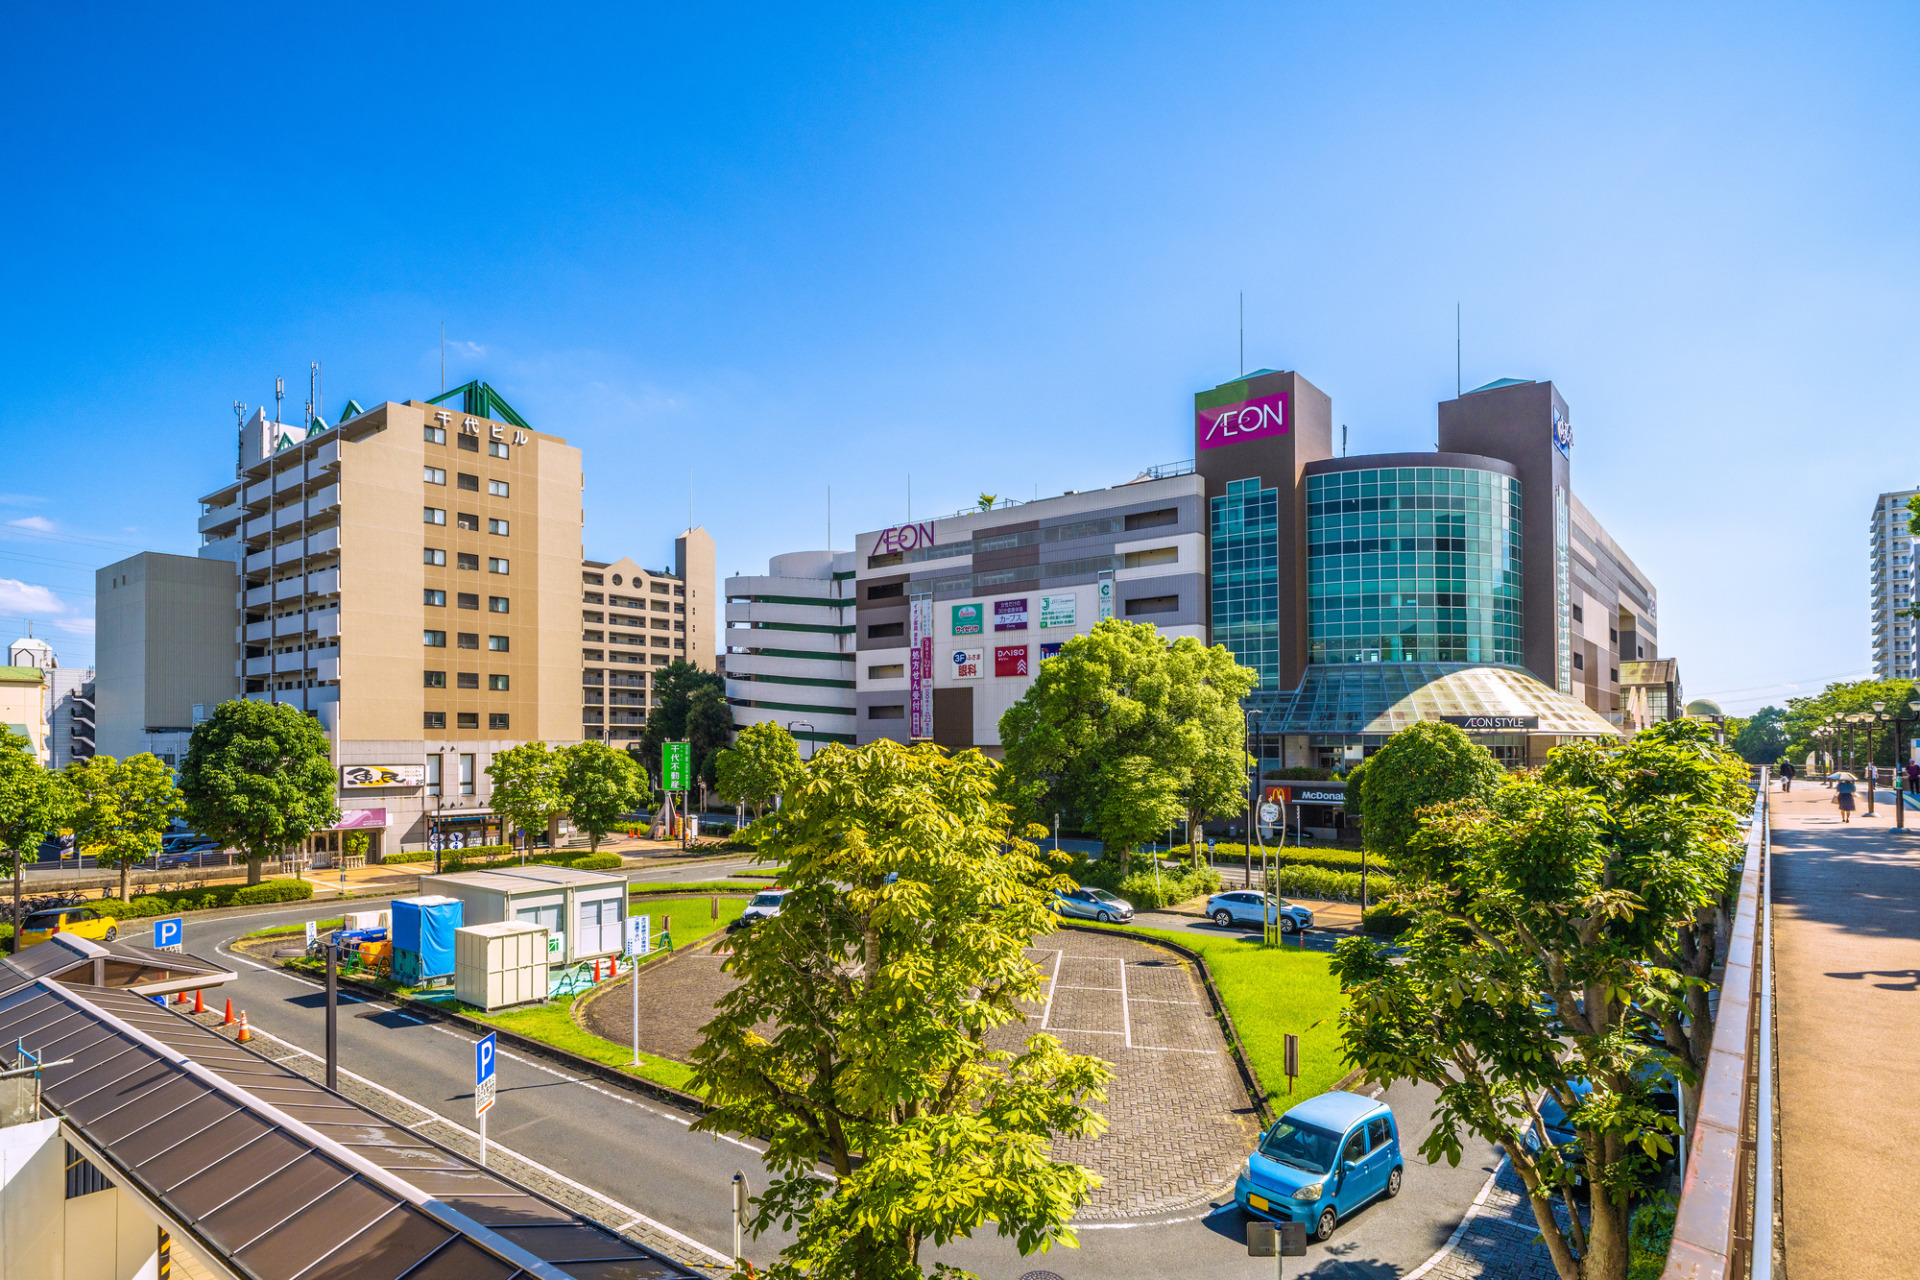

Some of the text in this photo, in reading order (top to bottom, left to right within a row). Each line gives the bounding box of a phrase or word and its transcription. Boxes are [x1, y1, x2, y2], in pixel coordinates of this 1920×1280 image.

[437, 411, 528, 445] 千代ビル
[955, 625, 979, 633] サイゼリヤ
[954, 654, 965, 662] 3F
[997, 649, 1024, 657] DAISO
[958, 664, 977, 677] 眼科
[912, 650, 920, 711] 処方せん受付
[1495, 718, 1524, 727] STYLE
[670, 744, 680, 789] 千代不動産
[1301, 791, 1346, 800] McDonal
[162, 922, 177, 944] P
[481, 1041, 492, 1078] P
